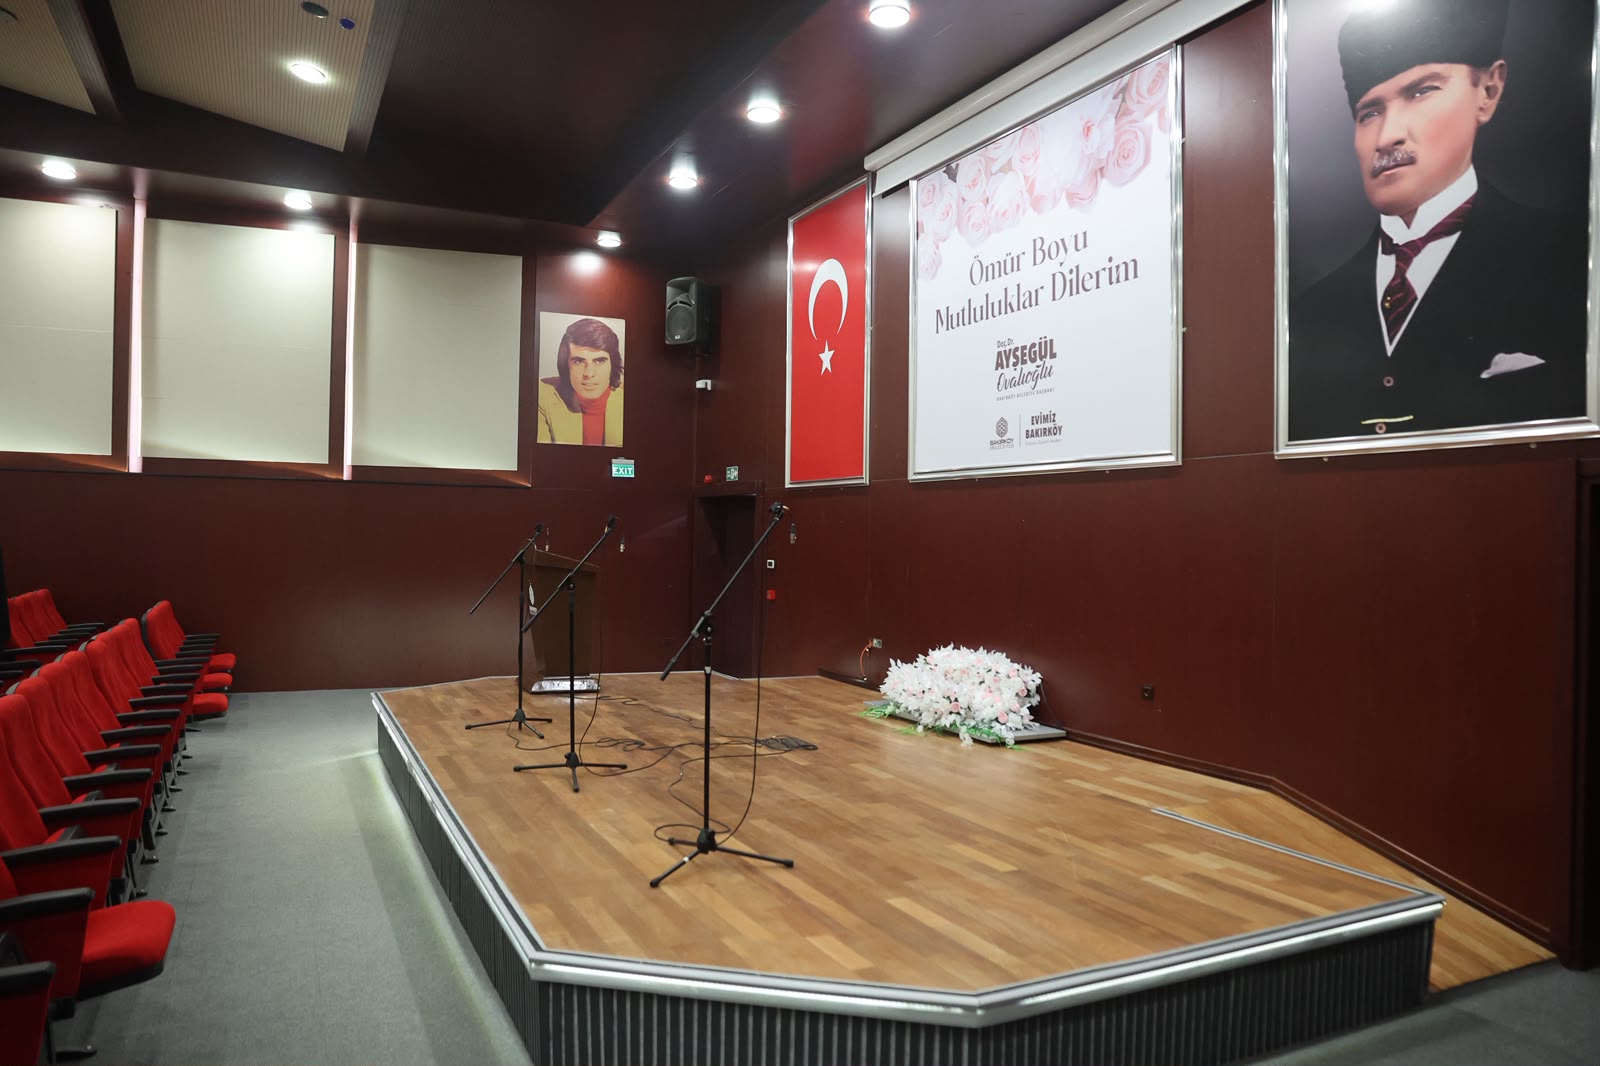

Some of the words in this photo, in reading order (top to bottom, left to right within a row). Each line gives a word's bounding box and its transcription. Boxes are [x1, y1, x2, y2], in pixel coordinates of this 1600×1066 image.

[969, 251, 1025, 286] Ömür
[1032, 230, 1088, 267] Boyu
[936, 283, 1044, 334] Mutluluklar
[1052, 256, 1139, 302] Dilerim
[995, 336, 1057, 371] AYŞEGÜL
[996, 360, 1054, 392] Ovalıoğlu
[1025, 423, 1063, 439] BAKIRKÖY
[1031, 410, 1056, 425] EVİMİZ
[613, 467, 633, 475] EXIT
